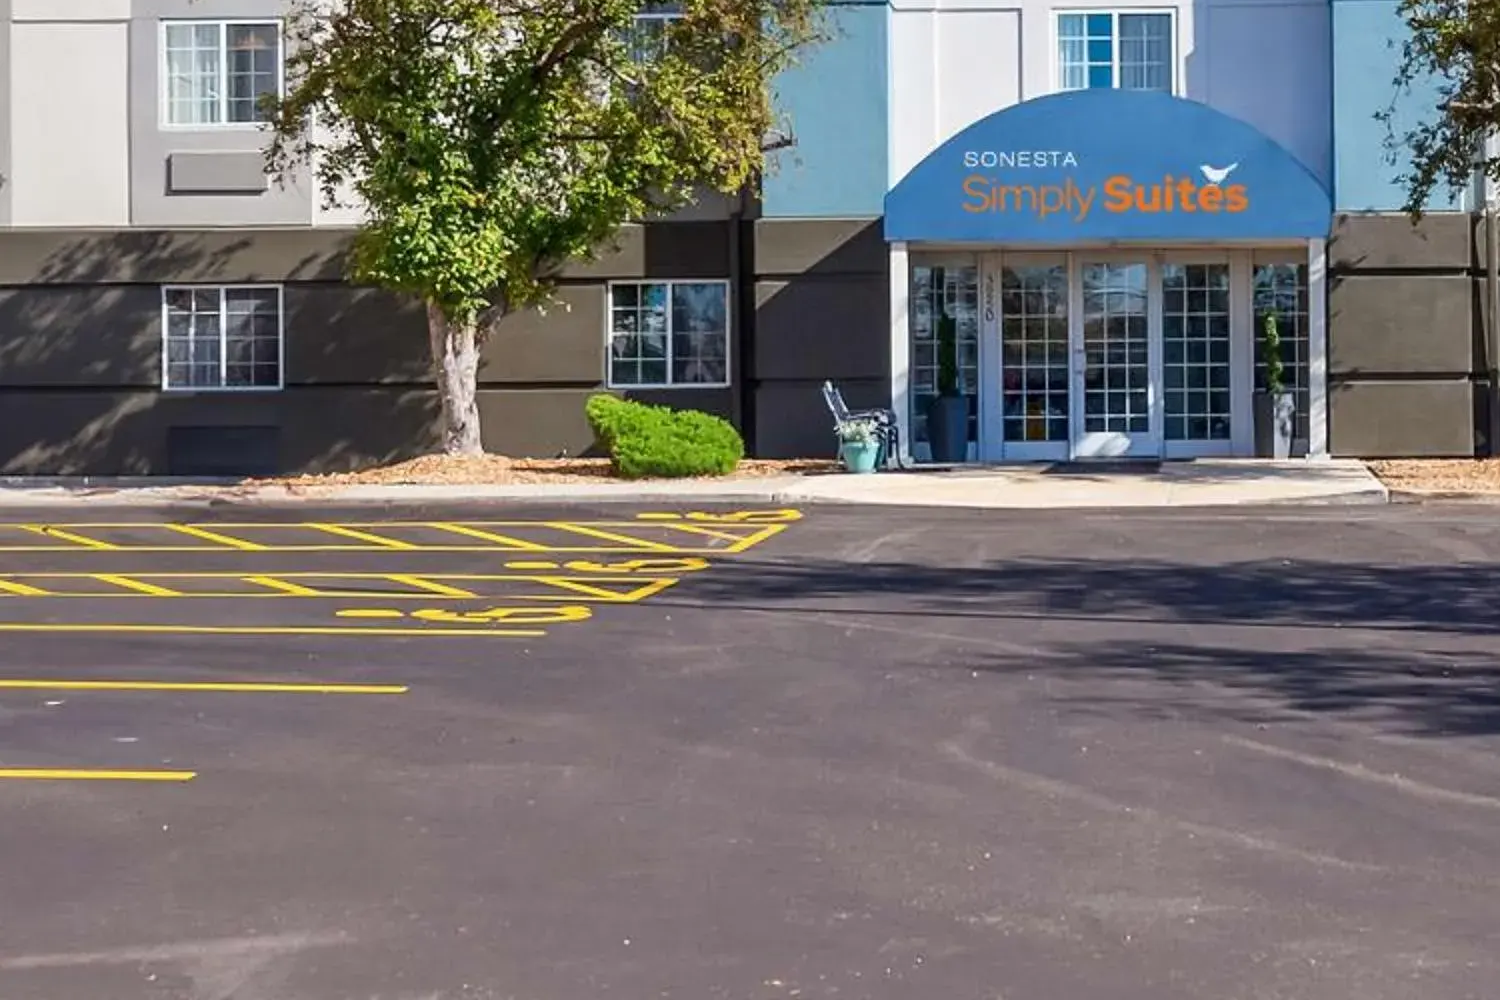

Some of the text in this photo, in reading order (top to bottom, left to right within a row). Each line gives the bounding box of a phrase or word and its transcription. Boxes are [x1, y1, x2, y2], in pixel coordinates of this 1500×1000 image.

[964, 151, 1078, 167] SONESTA
[962, 174, 1249, 222] Simply Suites
